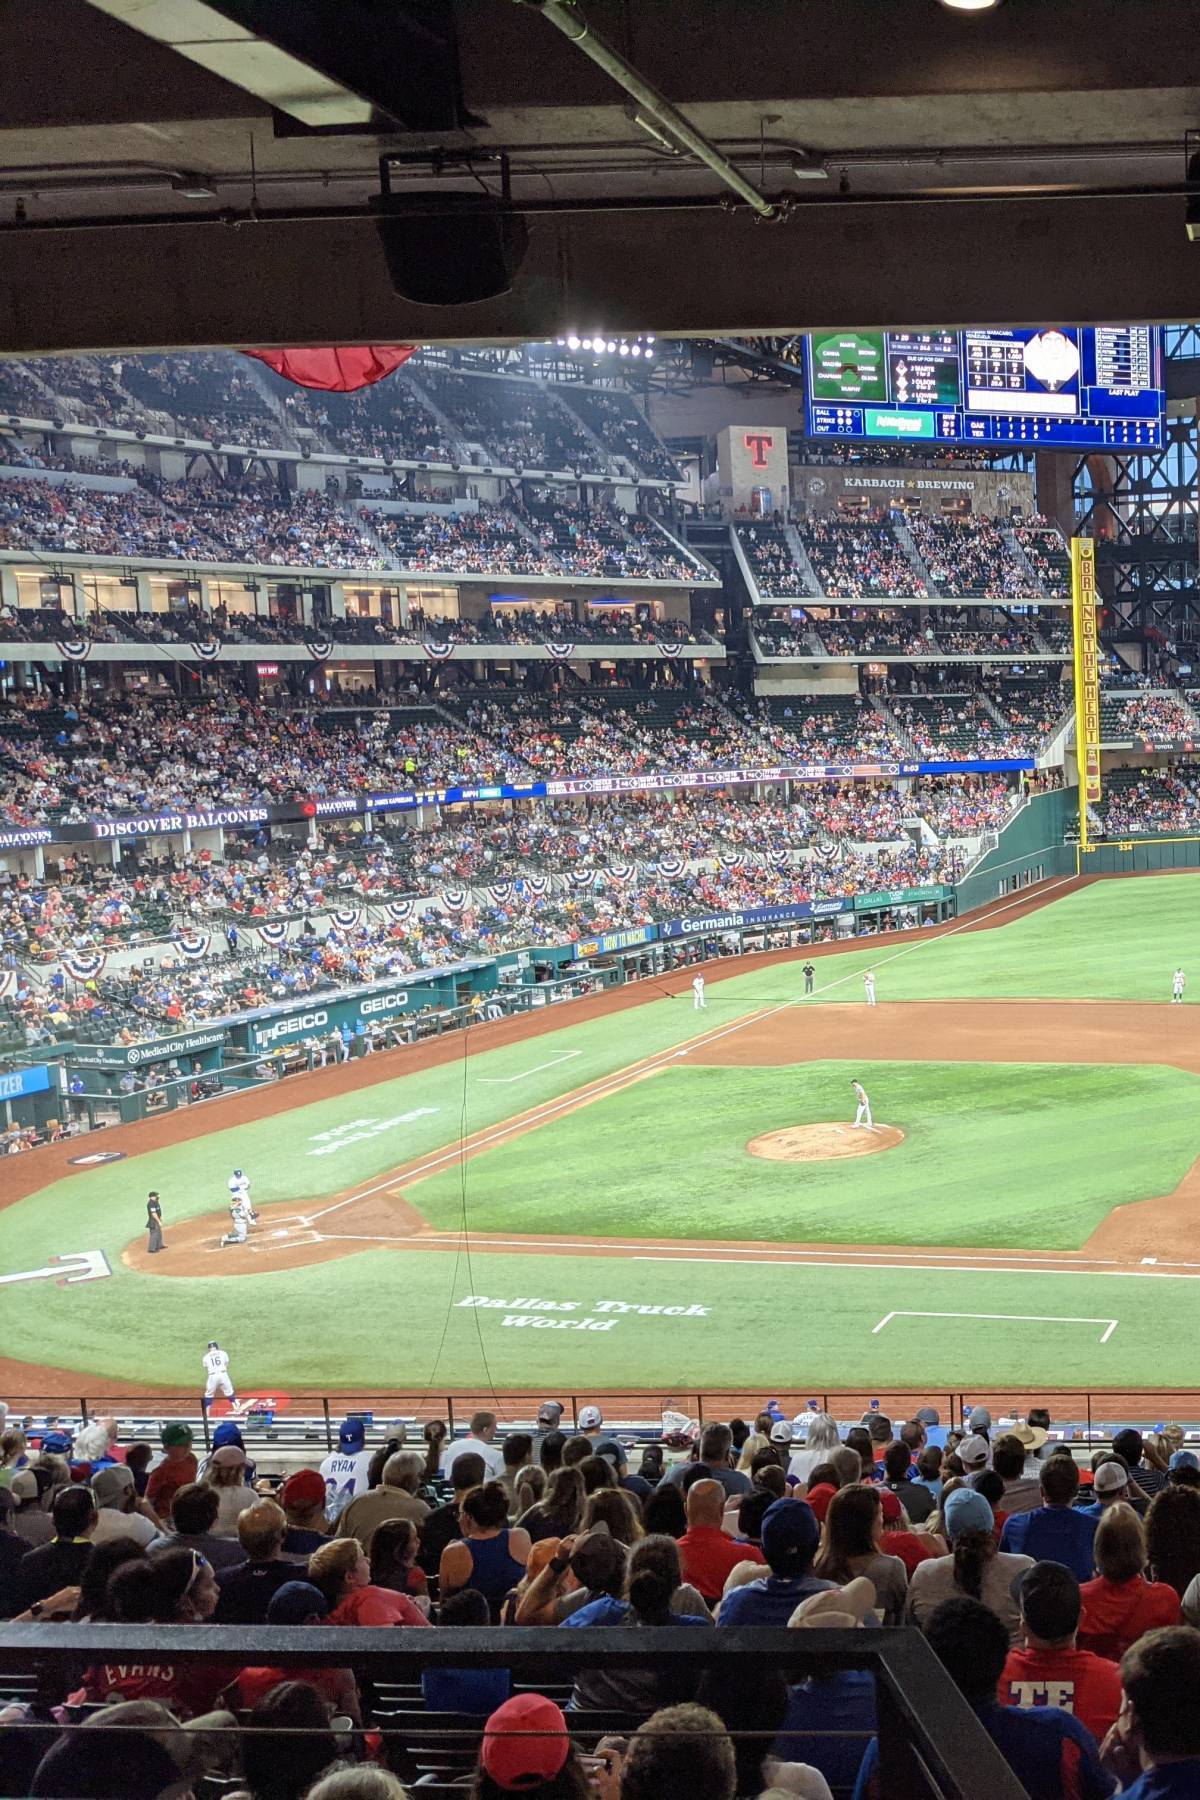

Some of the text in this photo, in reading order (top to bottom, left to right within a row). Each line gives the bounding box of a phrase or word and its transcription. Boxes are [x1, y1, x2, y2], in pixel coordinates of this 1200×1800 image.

[744, 434, 774, 468] T
[844, 477, 975, 491] KARBACH BREWING
[1082, 562, 1096, 742] BRING THE HEAT
[316, 801, 357, 811] BALCONES
[96, 808, 268, 837] DISCOVER BALCONES
[681, 911, 796, 933] Germania INSURANCE
[360, 992, 408, 1015] GEICO
[274, 1011, 328, 1035] GEICO
[141, 1033, 224, 1059] Medical City Healthcare
[453, 1295, 712, 1316] Dallas Truck
[500, 1315, 620, 1331] World
[210, 1356, 222, 1367] 16
[331, 1460, 356, 1473] RYAN
[105, 1664, 174, 1686] EVANS
